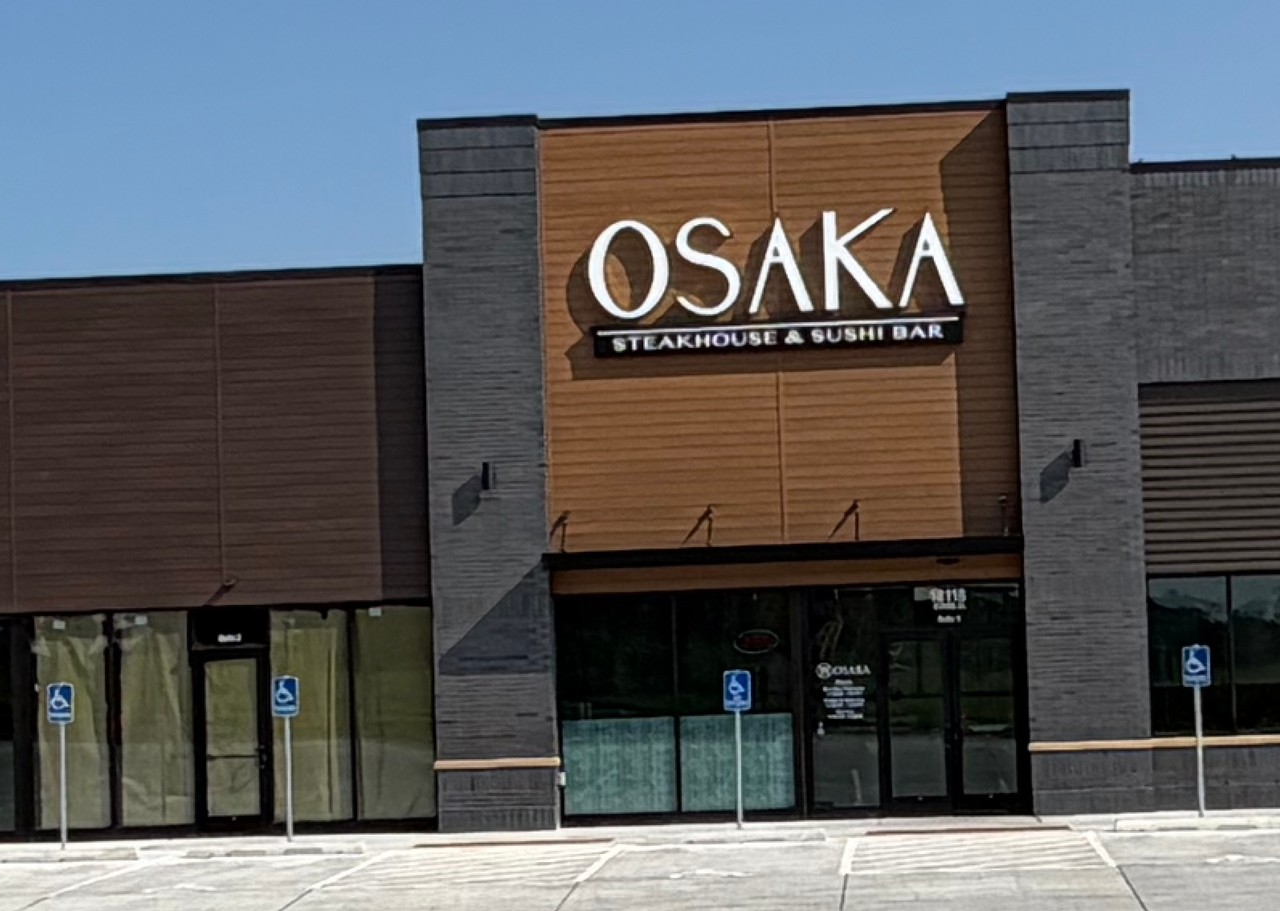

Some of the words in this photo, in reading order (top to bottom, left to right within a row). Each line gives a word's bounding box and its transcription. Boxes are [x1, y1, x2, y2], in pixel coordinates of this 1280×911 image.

[587, 207, 965, 320] OSAKA
[612, 330, 778, 353] STEAKHOUSE
[784, 329, 804, 345] &
[811, 325, 884, 344] SUSHI
[892, 323, 945, 341] BAR
